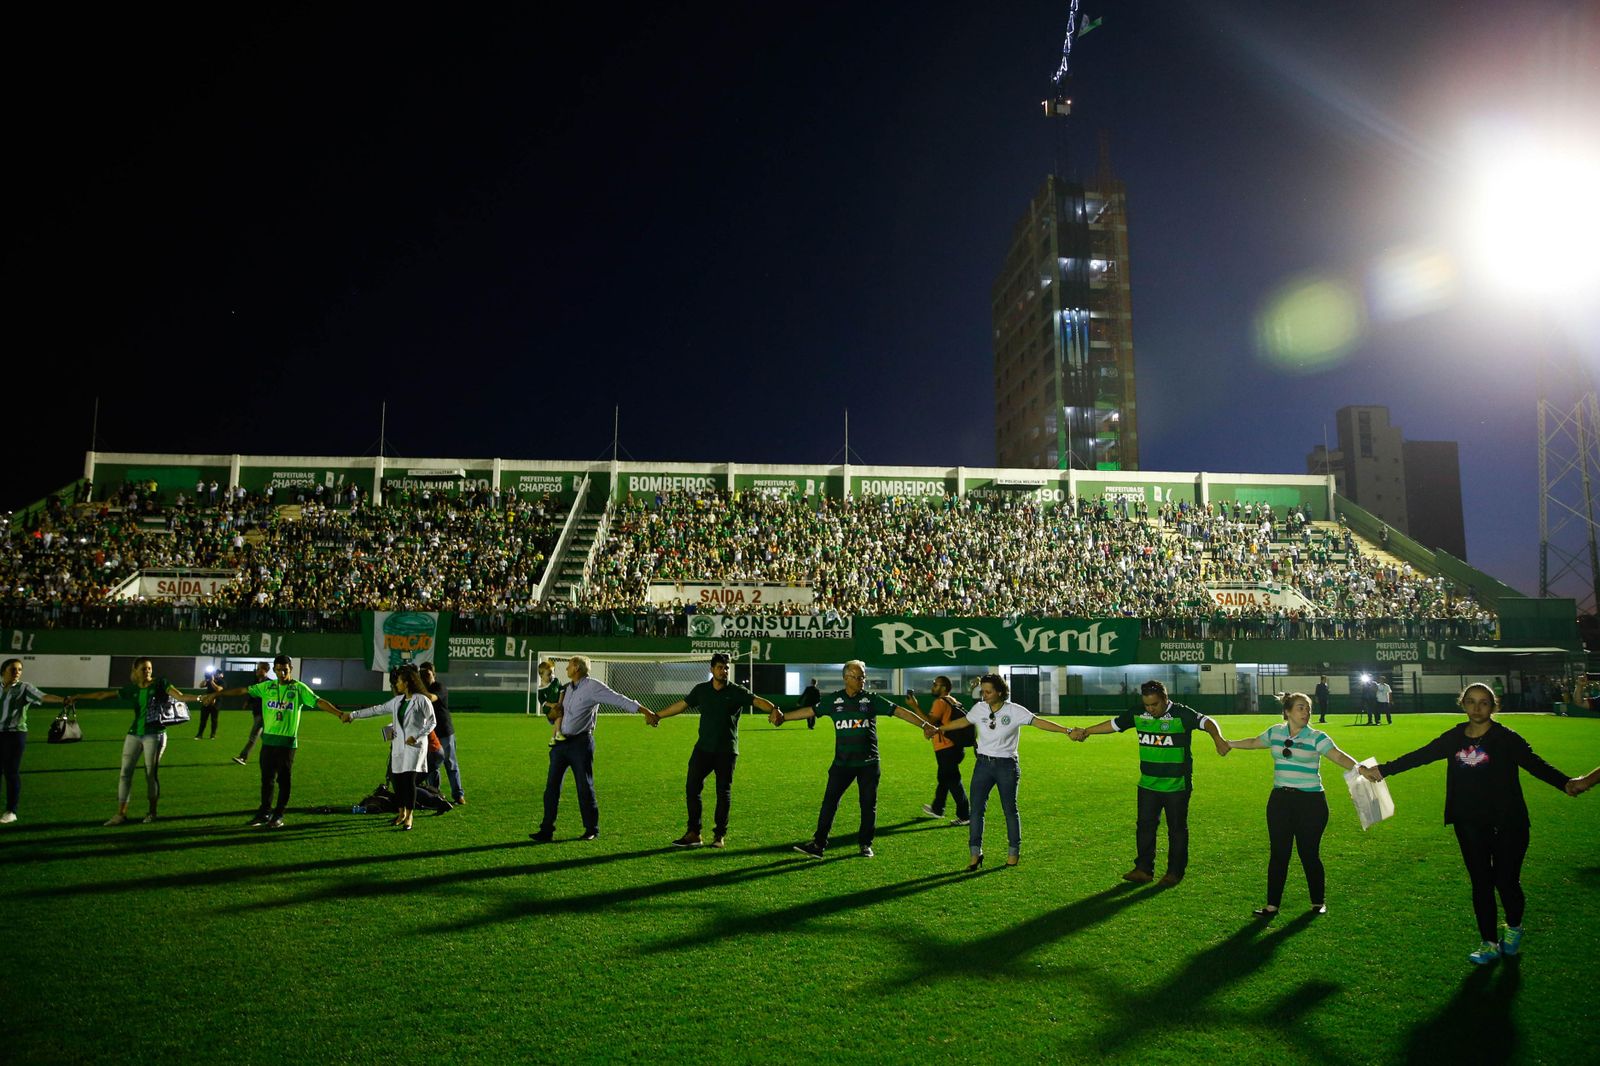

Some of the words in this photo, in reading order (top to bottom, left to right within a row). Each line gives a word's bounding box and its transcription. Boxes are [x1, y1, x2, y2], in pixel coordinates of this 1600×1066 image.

[629, 476, 716, 492] BOMBEIROS
[861, 480, 945, 496] BOMBEIROS
[1036, 488, 1064, 502] 190
[210, 581, 217, 595] 1
[752, 590, 761, 603] 2
[1262, 593, 1271, 605] 3
[202, 634, 240, 642] PREFEITURA
[241, 634, 250, 642] DE
[786, 630, 812, 638] MEIO
[816, 630, 850, 639] OESTE
[871, 620, 998, 659] Raça
[1013, 620, 1118, 655] Verde
[200, 641, 250, 655] CHAPECÓ
[485, 638, 495, 646] DE
[691, 640, 729, 648] PREFEITURA
[1160, 649, 1204, 661] CHAPECÓ
[835, 719, 870, 730] CAIXA
